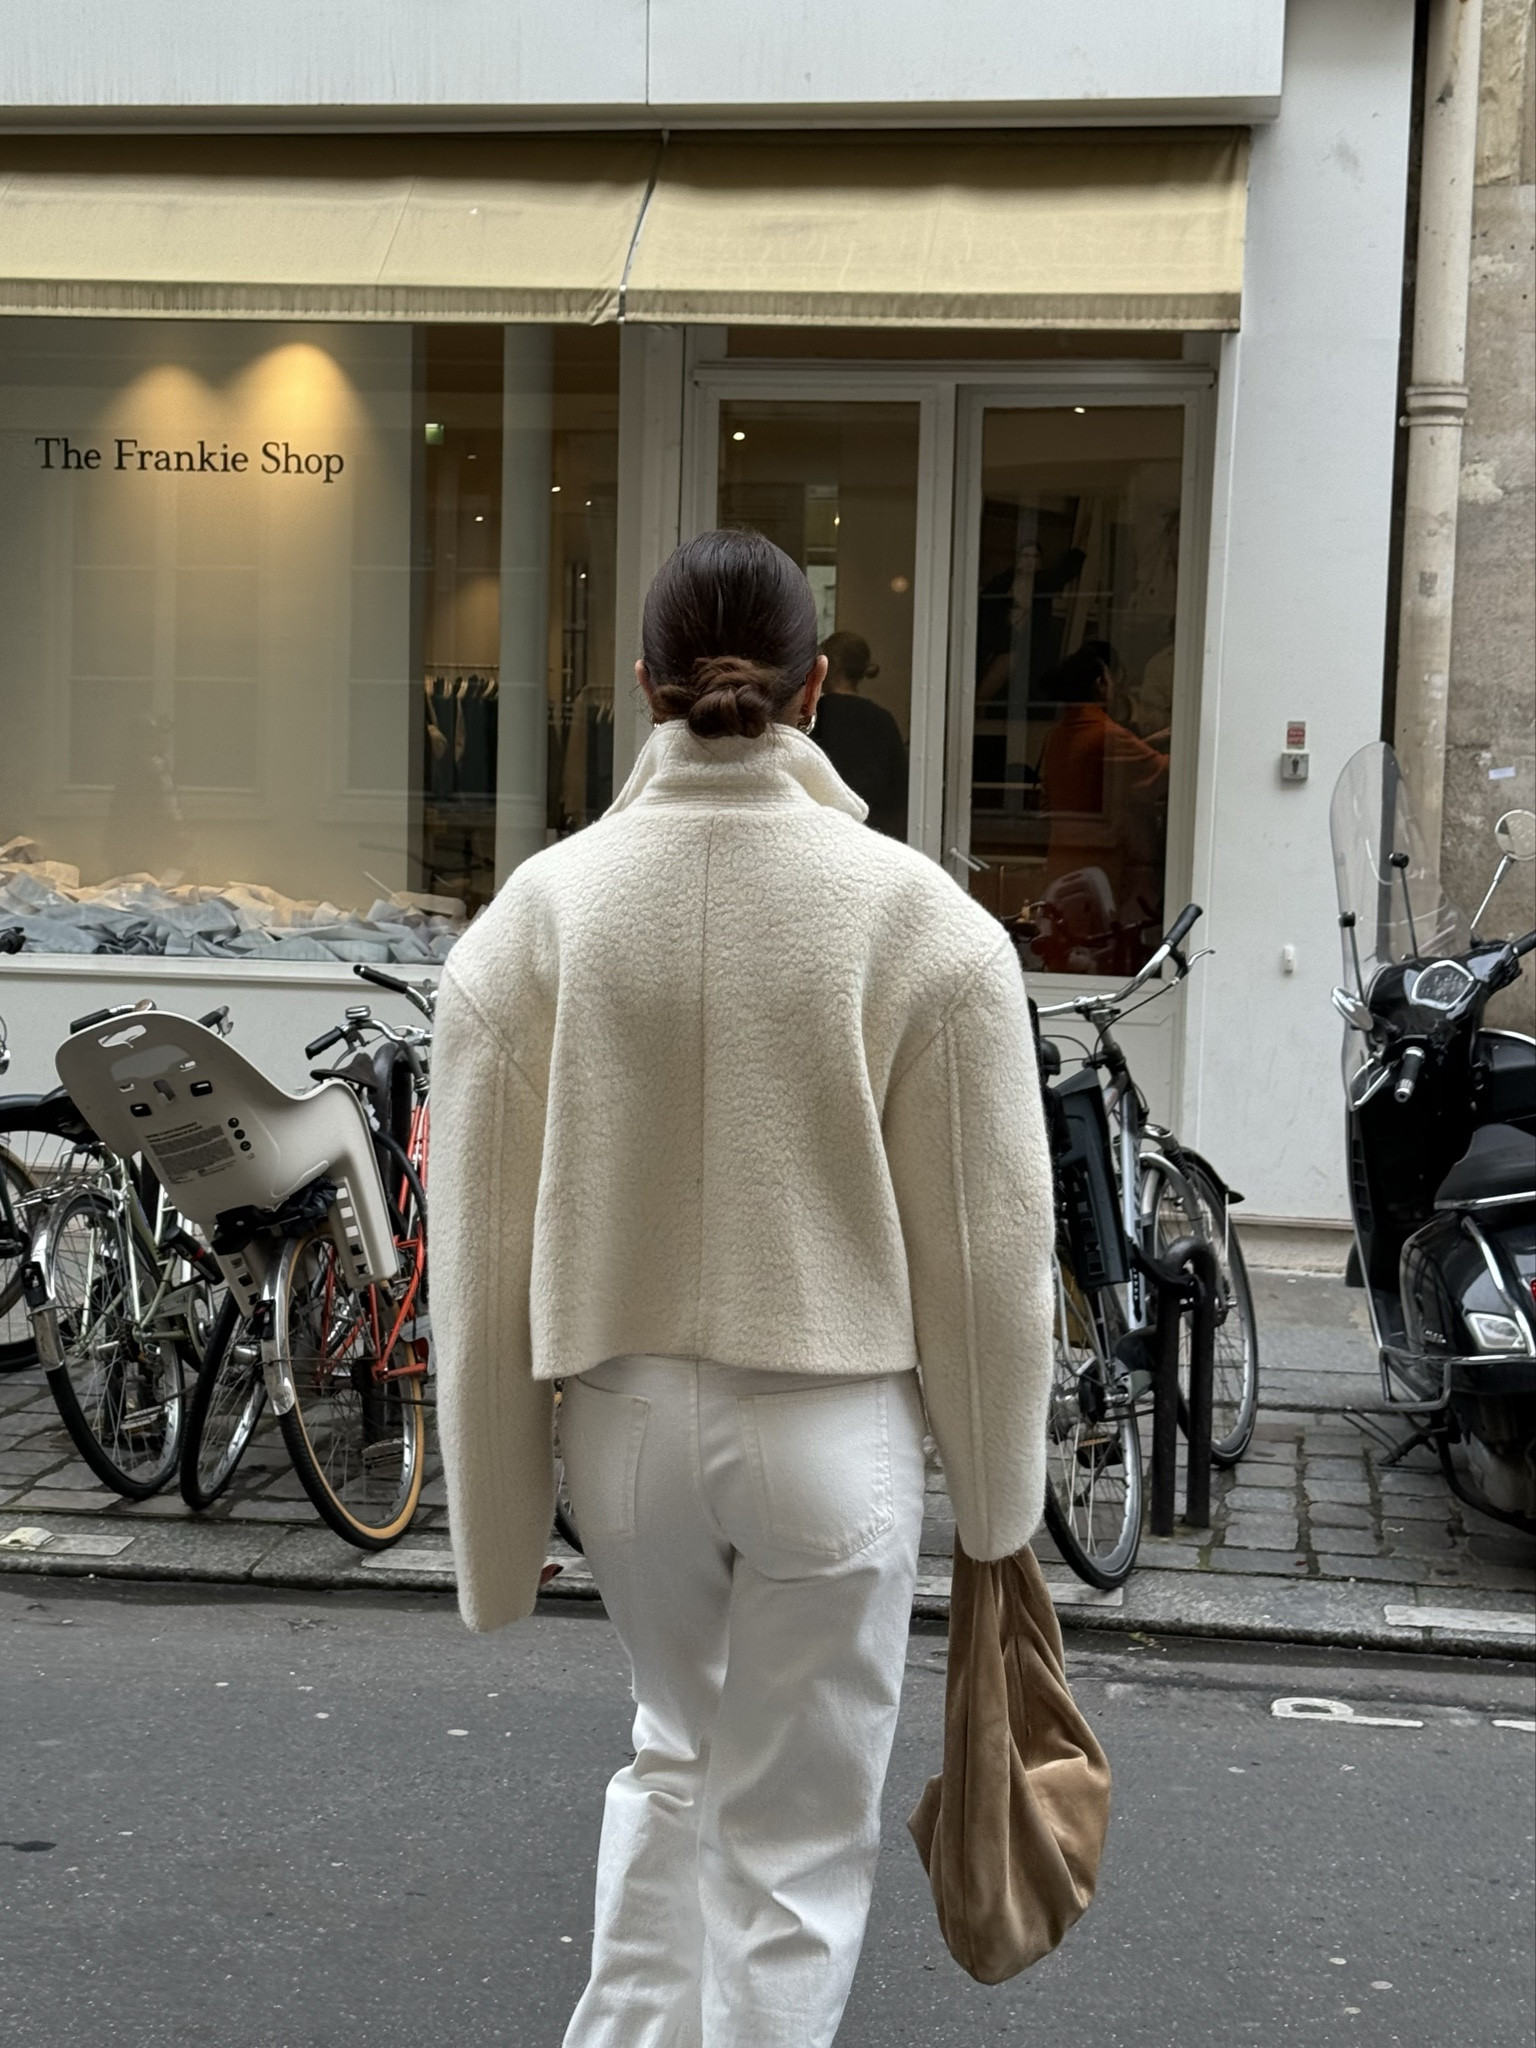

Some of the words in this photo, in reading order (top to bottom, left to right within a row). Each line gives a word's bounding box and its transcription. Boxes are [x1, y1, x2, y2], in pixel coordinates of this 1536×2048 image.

[34, 437, 102, 470] The
[113, 439, 249, 473] Frankie
[261, 441, 345, 484] Shop
